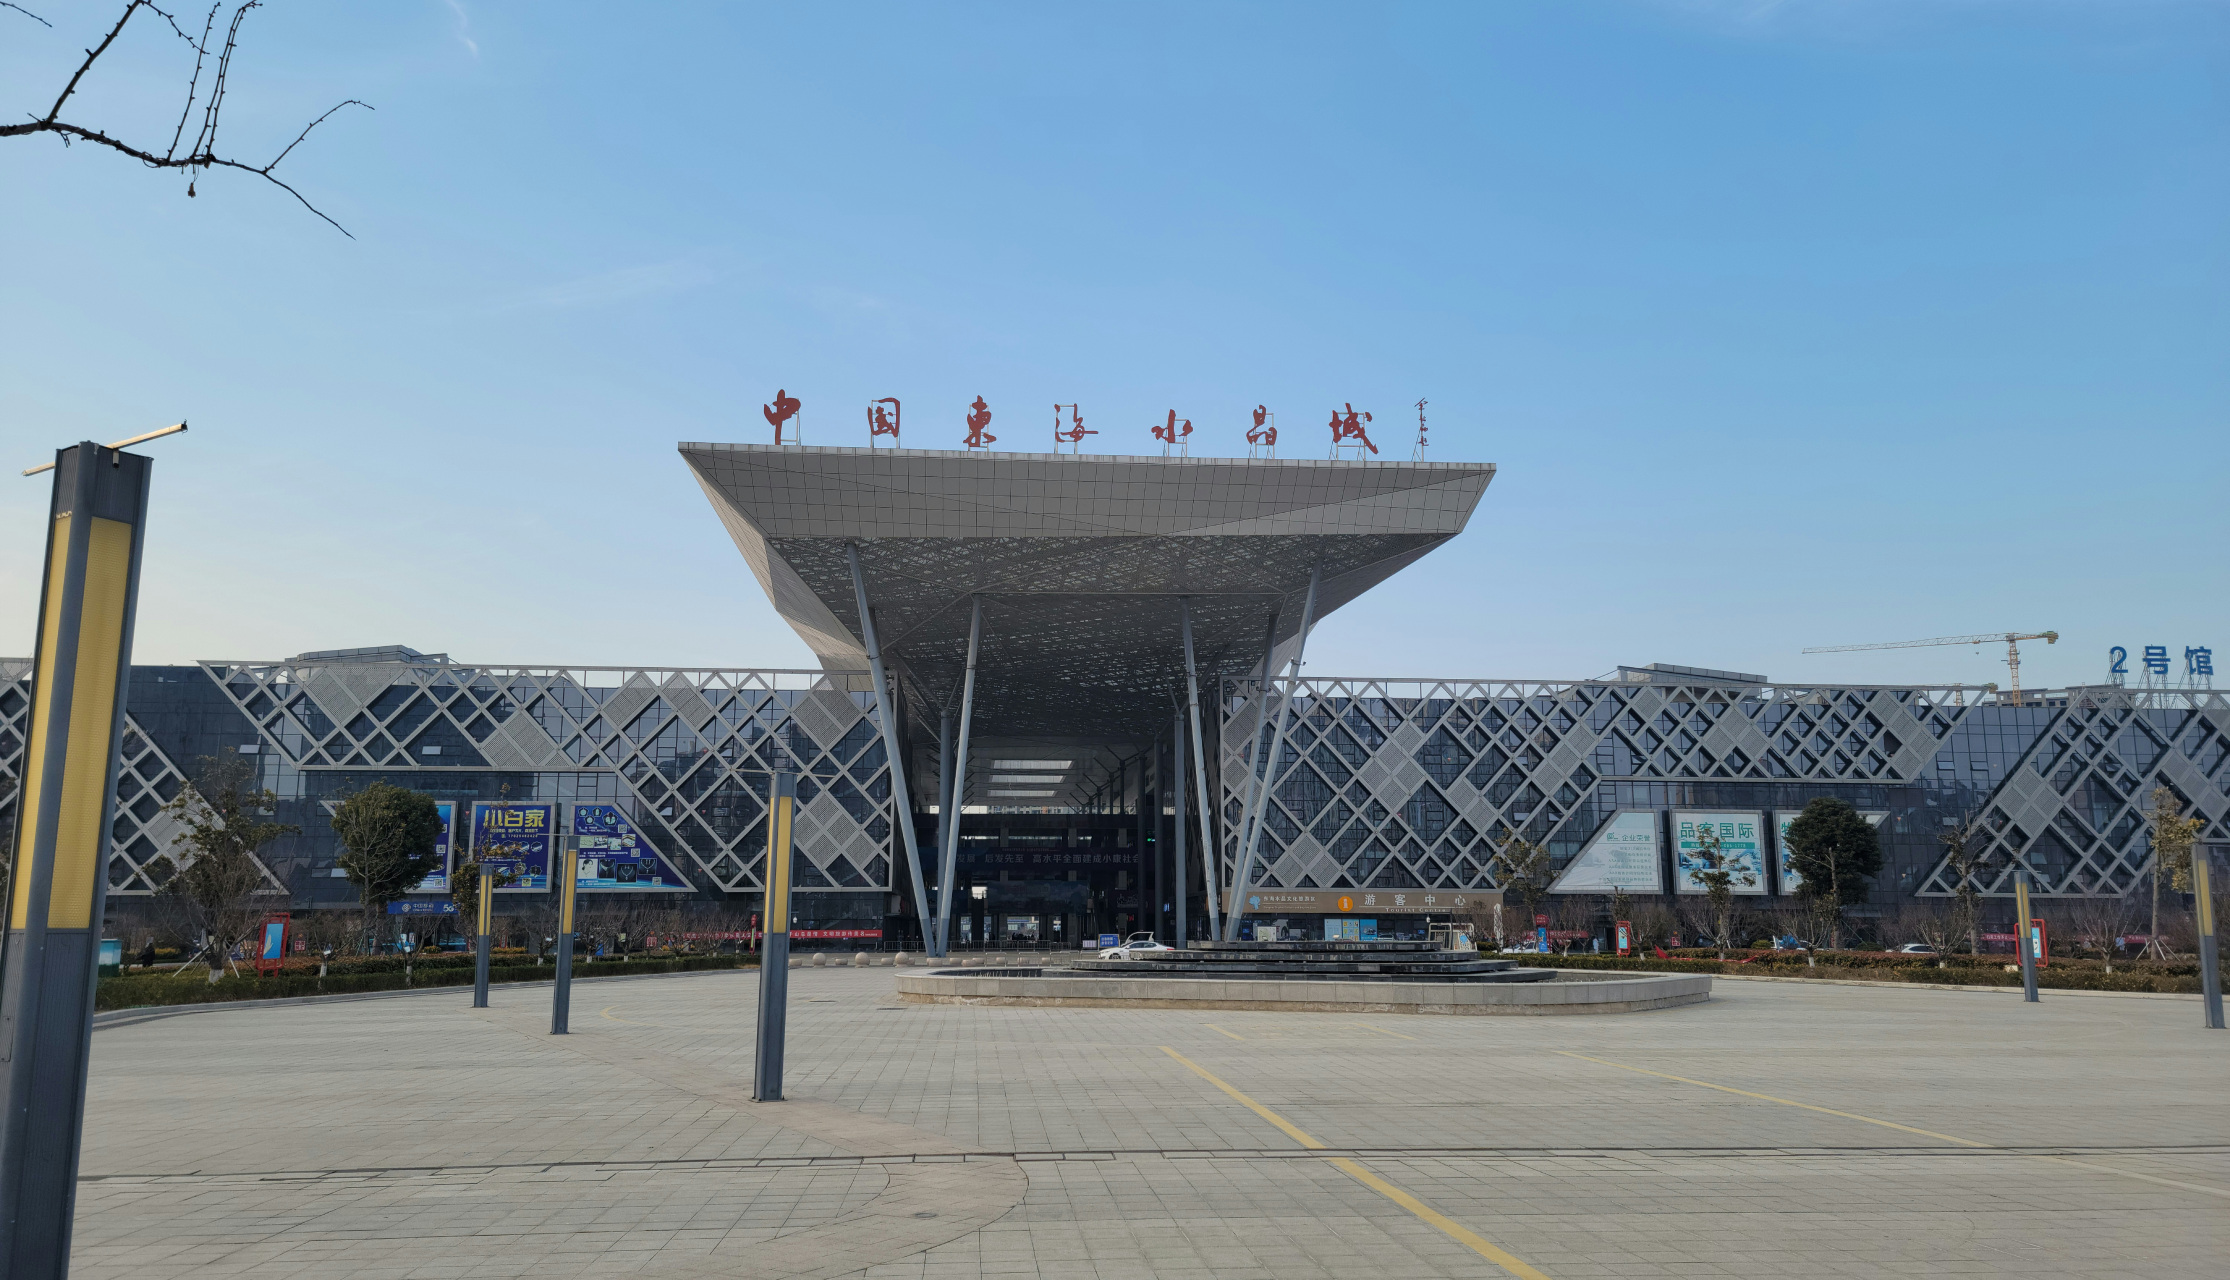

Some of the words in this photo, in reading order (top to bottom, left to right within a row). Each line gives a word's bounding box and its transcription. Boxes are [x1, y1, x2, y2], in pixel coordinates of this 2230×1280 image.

[2110, 645, 2214, 675] 2号馆
[483, 809, 545, 828] 小白家
[1680, 821, 1754, 839] 品客国际
[984, 853, 1025, 864] 后发先至
[1032, 853, 1139, 864] 高水平全面建成小康社会
[1364, 894, 1466, 907] 游客中心
